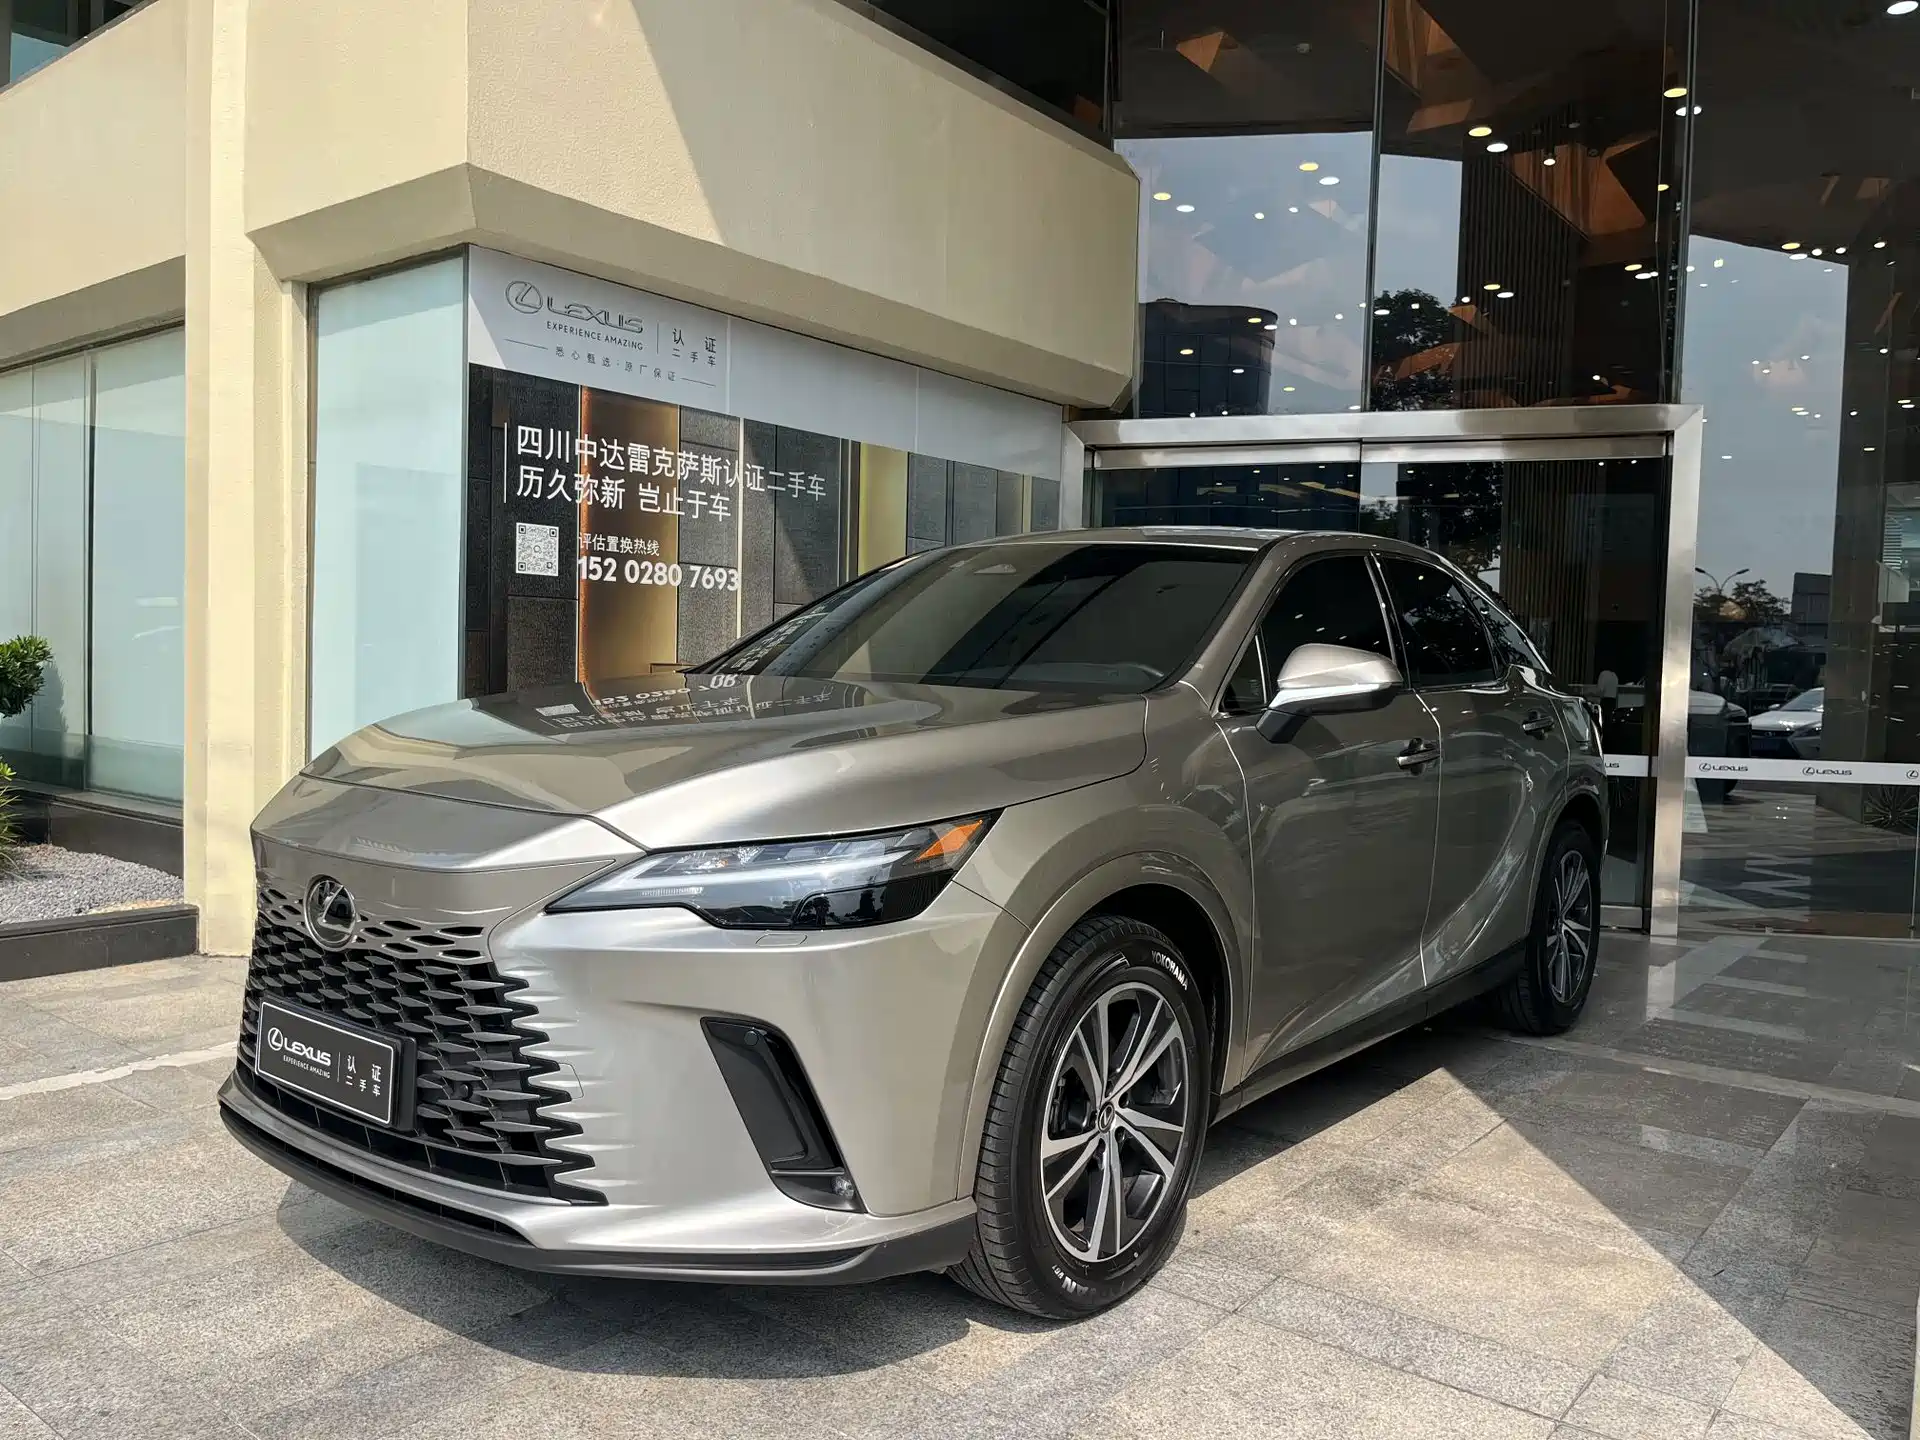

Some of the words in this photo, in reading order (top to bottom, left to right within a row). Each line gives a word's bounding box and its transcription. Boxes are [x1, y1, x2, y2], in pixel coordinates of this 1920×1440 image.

[547, 296, 644, 334] LEXUS
[547, 320, 602, 341] EXPERIENCE
[604, 335, 644, 351] AMAZING
[672, 327, 717, 354] 认证
[671, 348, 717, 368] 二手车
[517, 425, 826, 501] 四川中达雷克萨斯认证二手车
[516, 464, 626, 510] 历久弥新
[638, 481, 731, 522] 岂止于车
[578, 531, 660, 557] 评估置换热线
[578, 555, 617, 582] 152
[624, 559, 683, 587] 0280
[689, 564, 740, 592] 7693
[1815, 768, 1852, 776] LEXUS
[1151, 950, 1189, 991] YOKOHAMA
[283, 1054, 309, 1072] EXPERIENCE
[309, 1063, 331, 1079] AMAZING
[284, 1037, 332, 1067] LEXUS
[347, 1054, 382, 1083] 认证
[345, 1075, 381, 1097] 二手车
